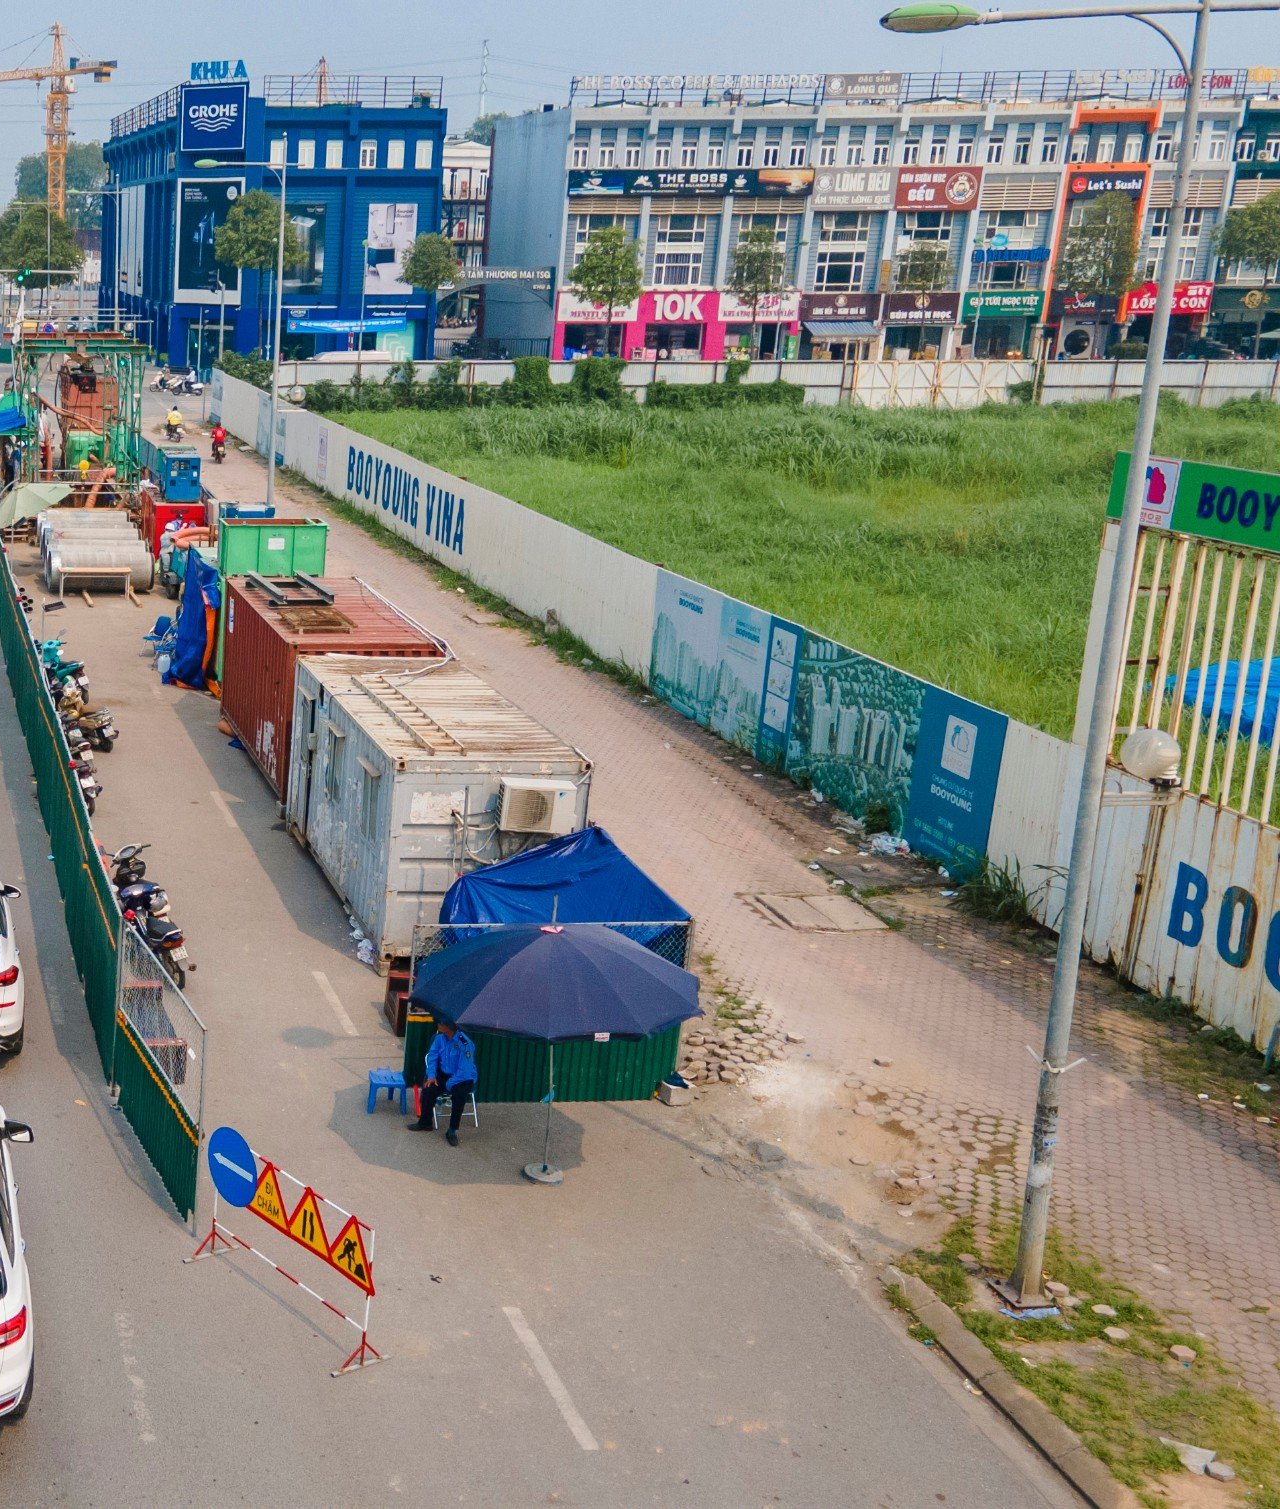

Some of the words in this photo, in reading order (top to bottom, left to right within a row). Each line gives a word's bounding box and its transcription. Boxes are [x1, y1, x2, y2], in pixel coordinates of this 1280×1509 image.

[191, 61, 229, 80] KHU
[233, 60, 248, 78] A
[1210, 75, 1233, 88] CON
[189, 104, 238, 119] GROHE
[658, 173, 686, 183] THE
[690, 173, 728, 183] BOSS
[1088, 179, 1113, 191] Let's
[1114, 178, 1143, 190] Sushi
[654, 293, 706, 321] 10K
[1180, 297, 1208, 309] CON
[347, 445, 420, 529] BOOYOUNG
[425, 483, 465, 555] VINA
[930, 783, 972, 813] BOOYOUNG
